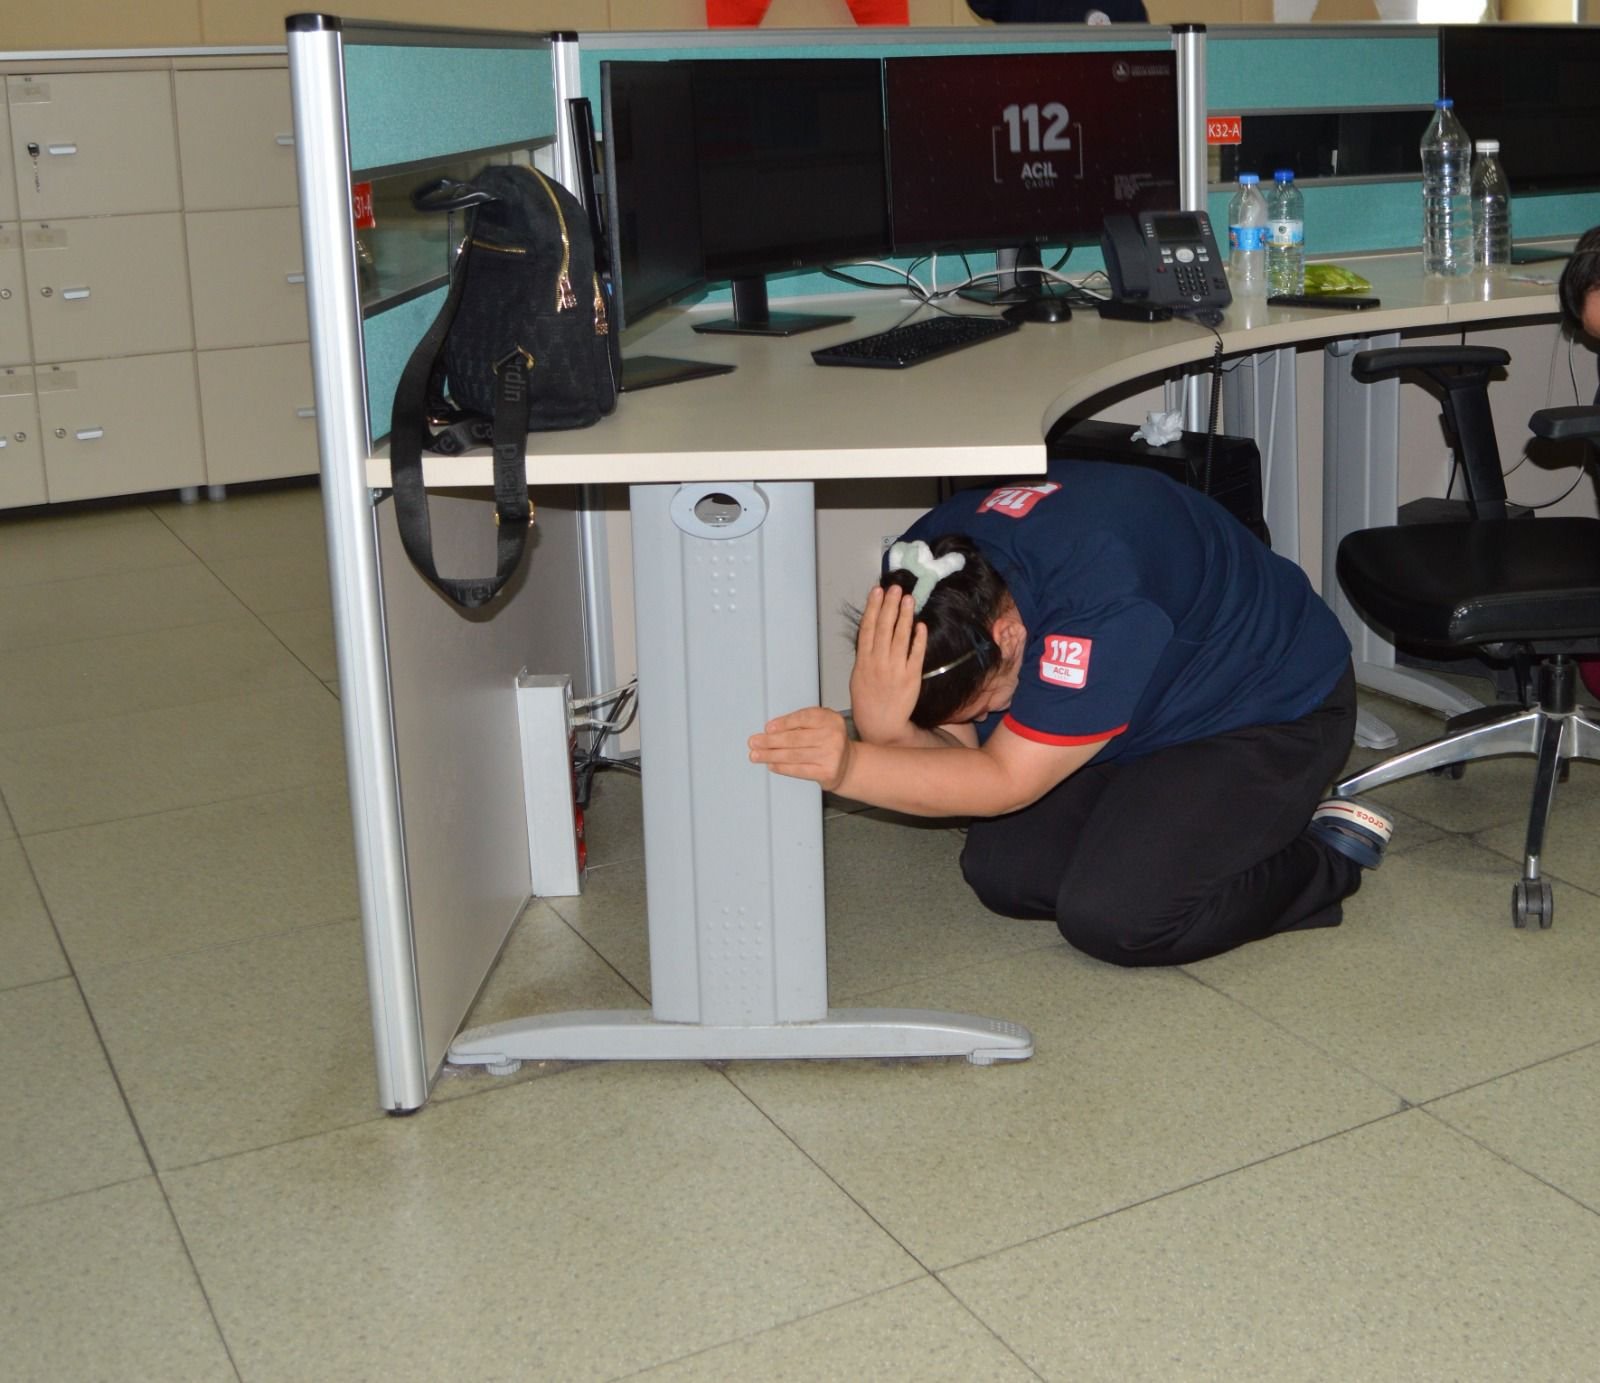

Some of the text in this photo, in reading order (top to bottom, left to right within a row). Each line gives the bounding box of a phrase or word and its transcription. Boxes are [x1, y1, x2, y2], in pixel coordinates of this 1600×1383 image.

[1003, 102, 1071, 153] 112
[1208, 123, 1240, 137] K32-A
[354, 194, 373, 219] 31-A
[504, 357, 527, 402] rdin
[1051, 640, 1082, 665] 112
[1356, 811, 1384, 829] crocs
